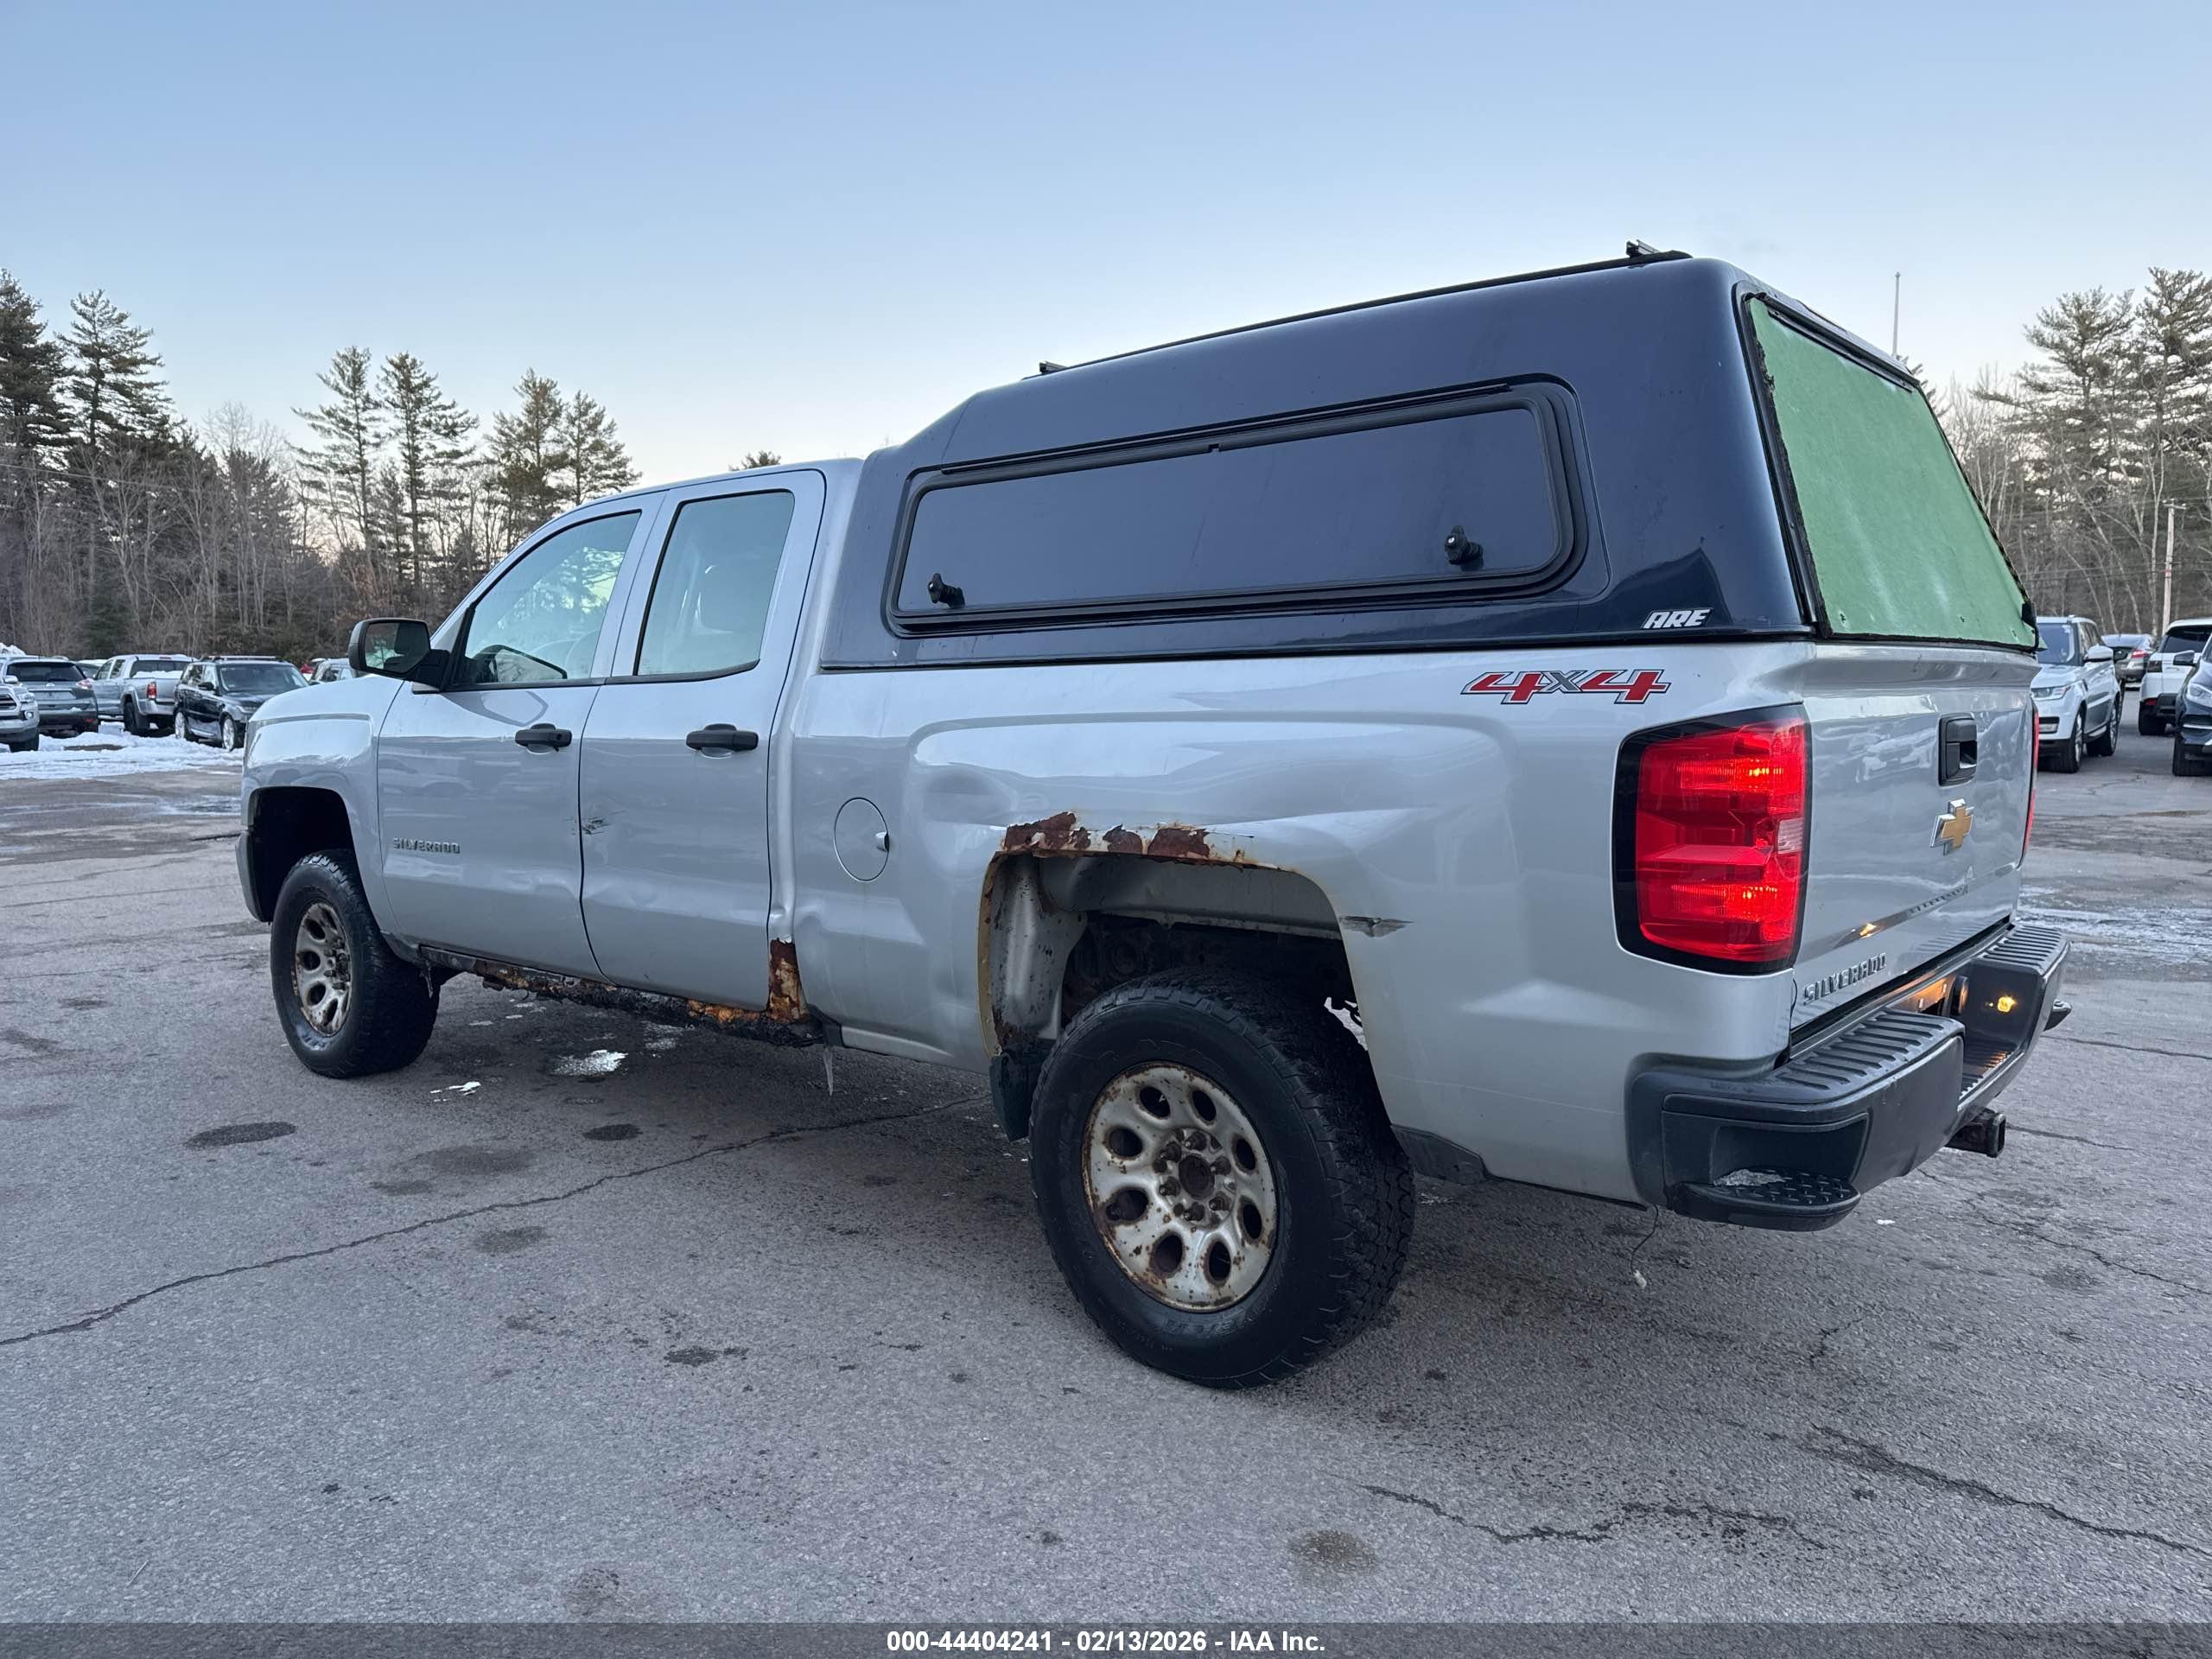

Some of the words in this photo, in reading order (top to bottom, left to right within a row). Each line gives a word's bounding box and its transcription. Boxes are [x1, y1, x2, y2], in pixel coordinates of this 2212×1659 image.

[1644, 609, 1709, 629] ARE
[393, 837, 461, 855] SILVERADO
[1803, 952, 1886, 1006] SILVERADO
